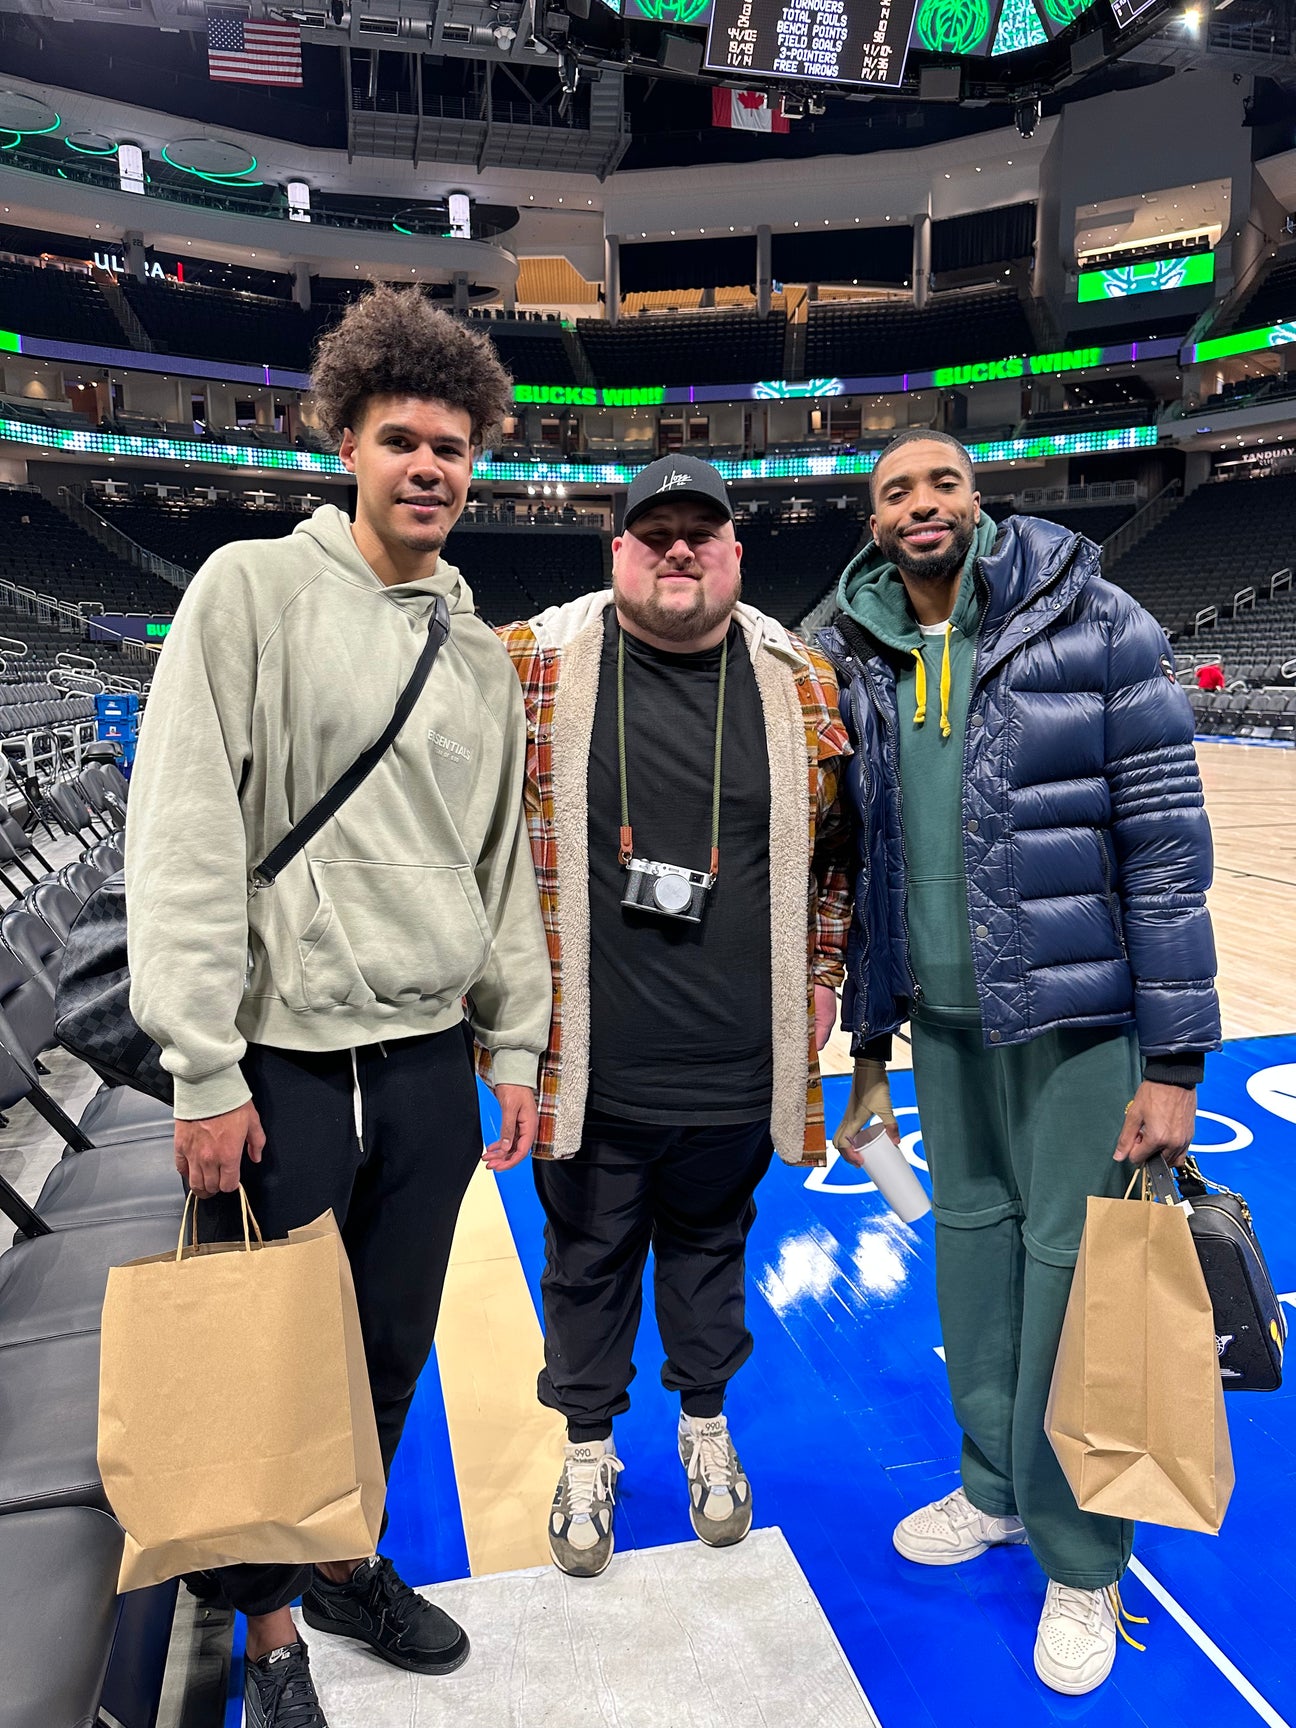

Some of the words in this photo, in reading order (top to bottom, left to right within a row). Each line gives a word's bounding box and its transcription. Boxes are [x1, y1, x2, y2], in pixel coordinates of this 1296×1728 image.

[782, 7, 811, 23] TOTAL
[816, 11, 848, 27] FOULS
[776, 20, 809, 36] BENCH
[812, 24, 848, 40] POINTS
[777, 33, 808, 48] FIELD
[811, 37, 843, 52] GOALS
[779, 46, 838, 65] 3-POINTERS
[773, 58, 799, 73] FREE
[803, 62, 839, 77] THROWS
[935, 357, 1024, 387] BUCKS
[1029, 347, 1101, 375] WIN!!
[514, 384, 598, 406] BUCKS
[602, 386, 664, 406] WIN!!
[1241, 447, 1295, 461] TANDUAY
[705, 1421, 720, 1431] 990
[574, 1448, 591, 1457] 990
